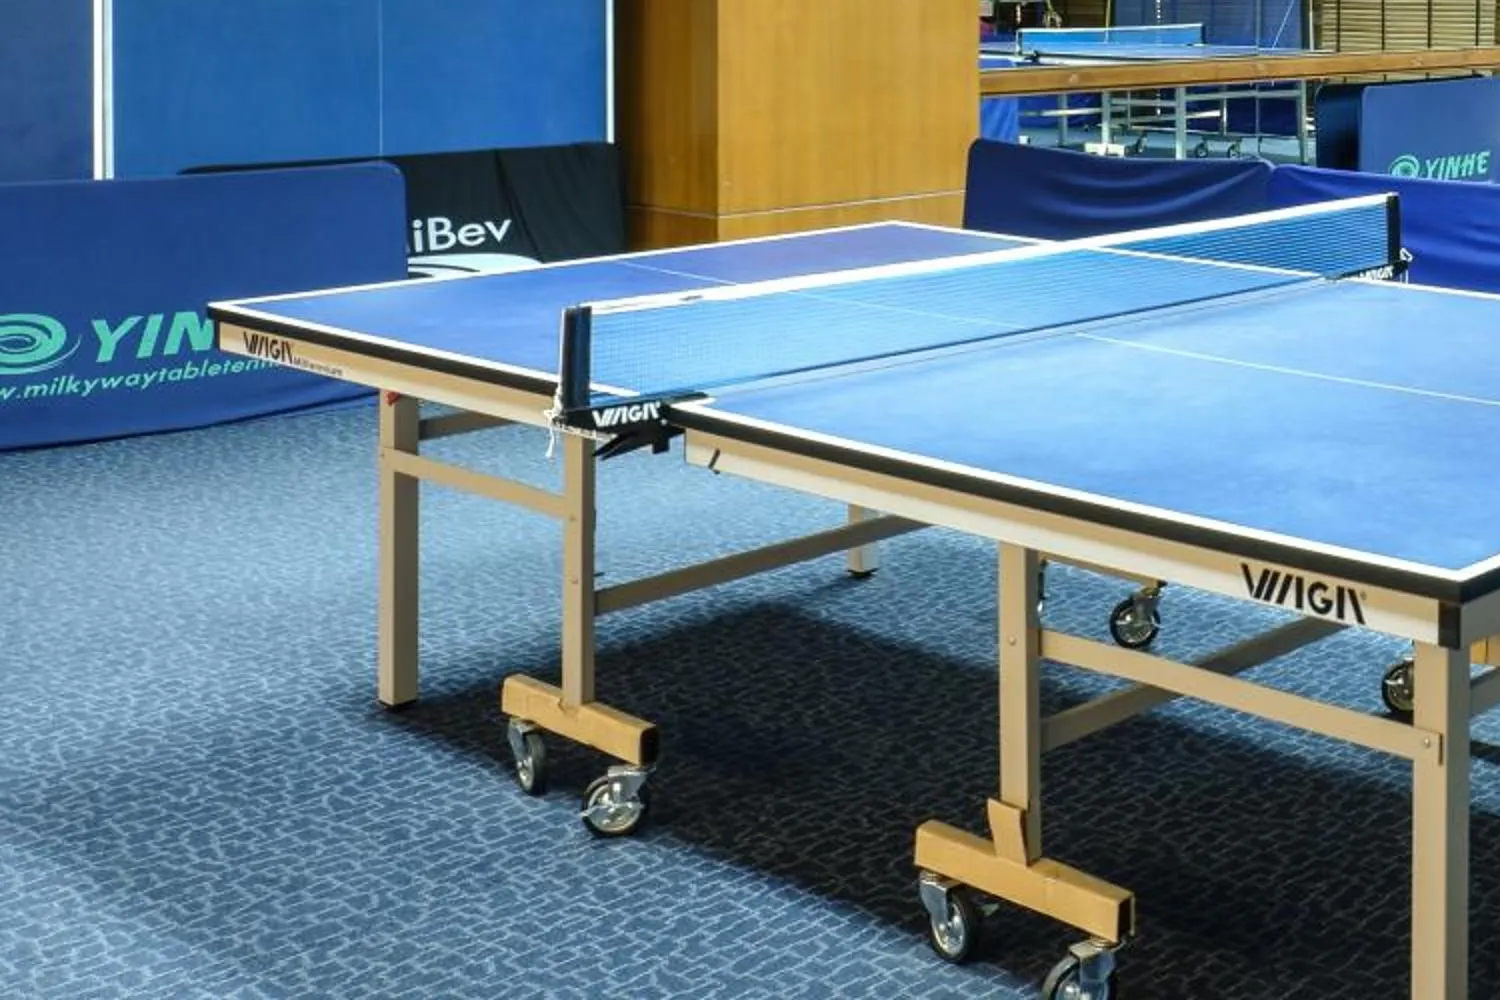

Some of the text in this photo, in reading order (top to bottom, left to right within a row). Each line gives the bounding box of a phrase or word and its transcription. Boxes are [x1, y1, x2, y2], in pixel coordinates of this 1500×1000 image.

[1425, 151, 1490, 180] YINHE
[405, 216, 513, 253] iBev
[90, 311, 215, 363] YIN
